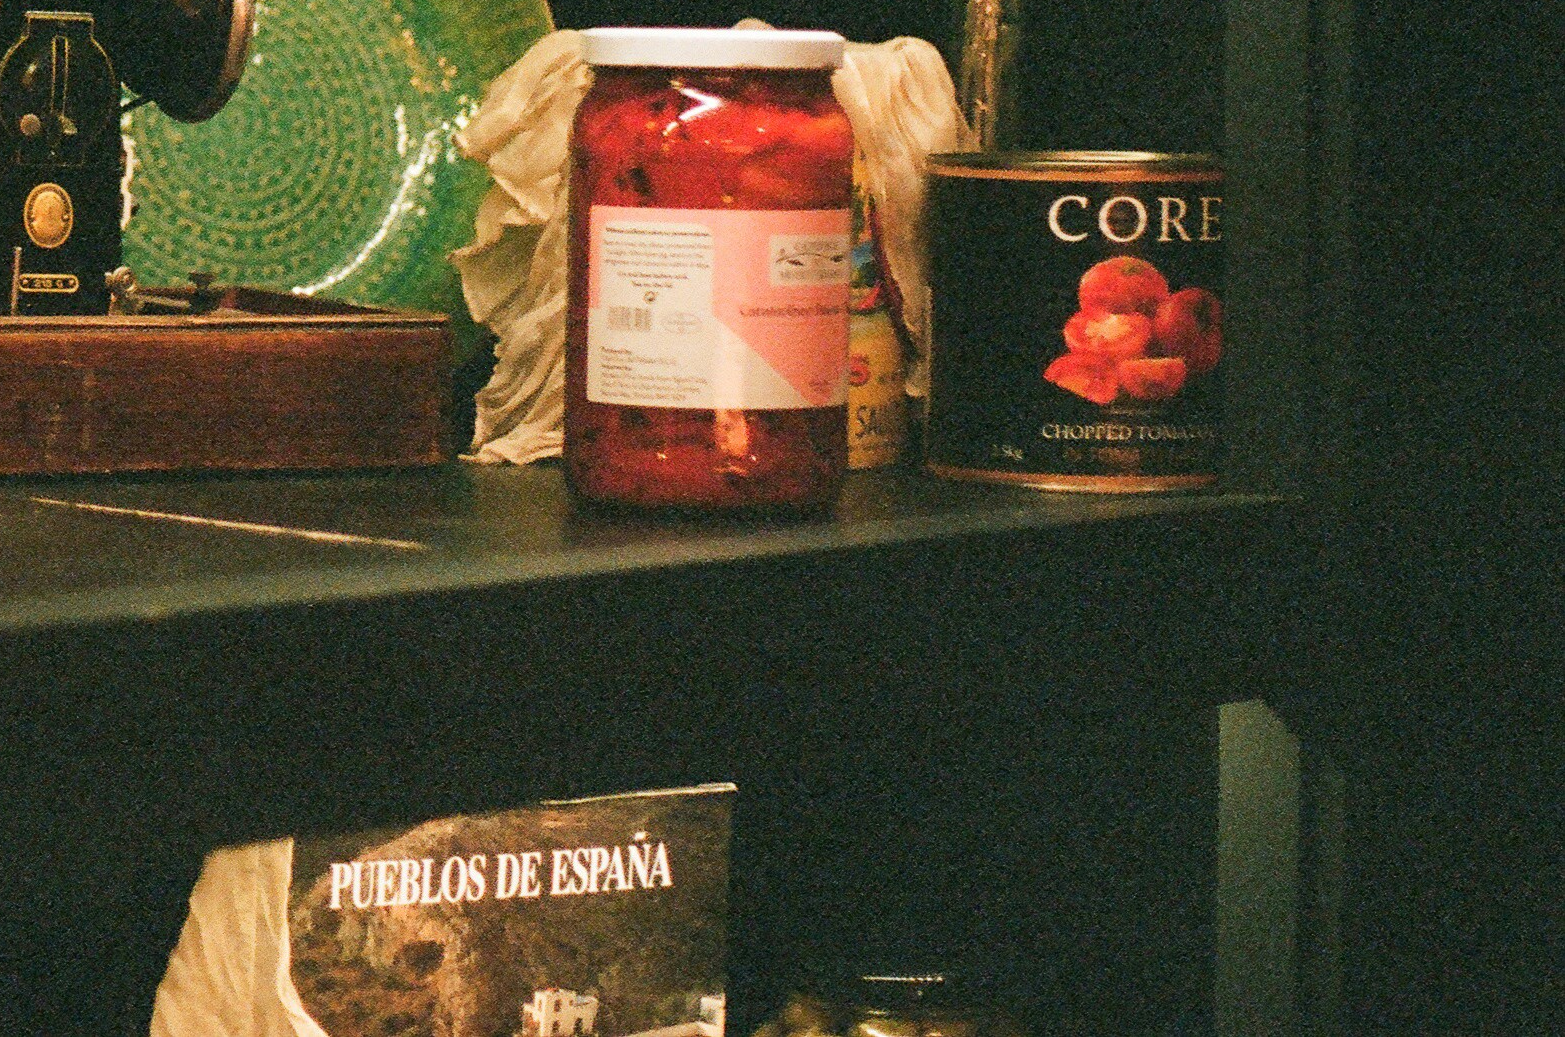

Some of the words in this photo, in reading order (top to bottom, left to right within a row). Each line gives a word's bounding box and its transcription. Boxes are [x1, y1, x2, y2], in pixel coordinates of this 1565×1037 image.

[1047, 195, 1223, 243] CORE
[1042, 423, 1133, 441] CHOPPED
[328, 855, 487, 910] PUEBLOS
[496, 851, 544, 900] DE
[550, 832, 672, 895] ESPAÑA
